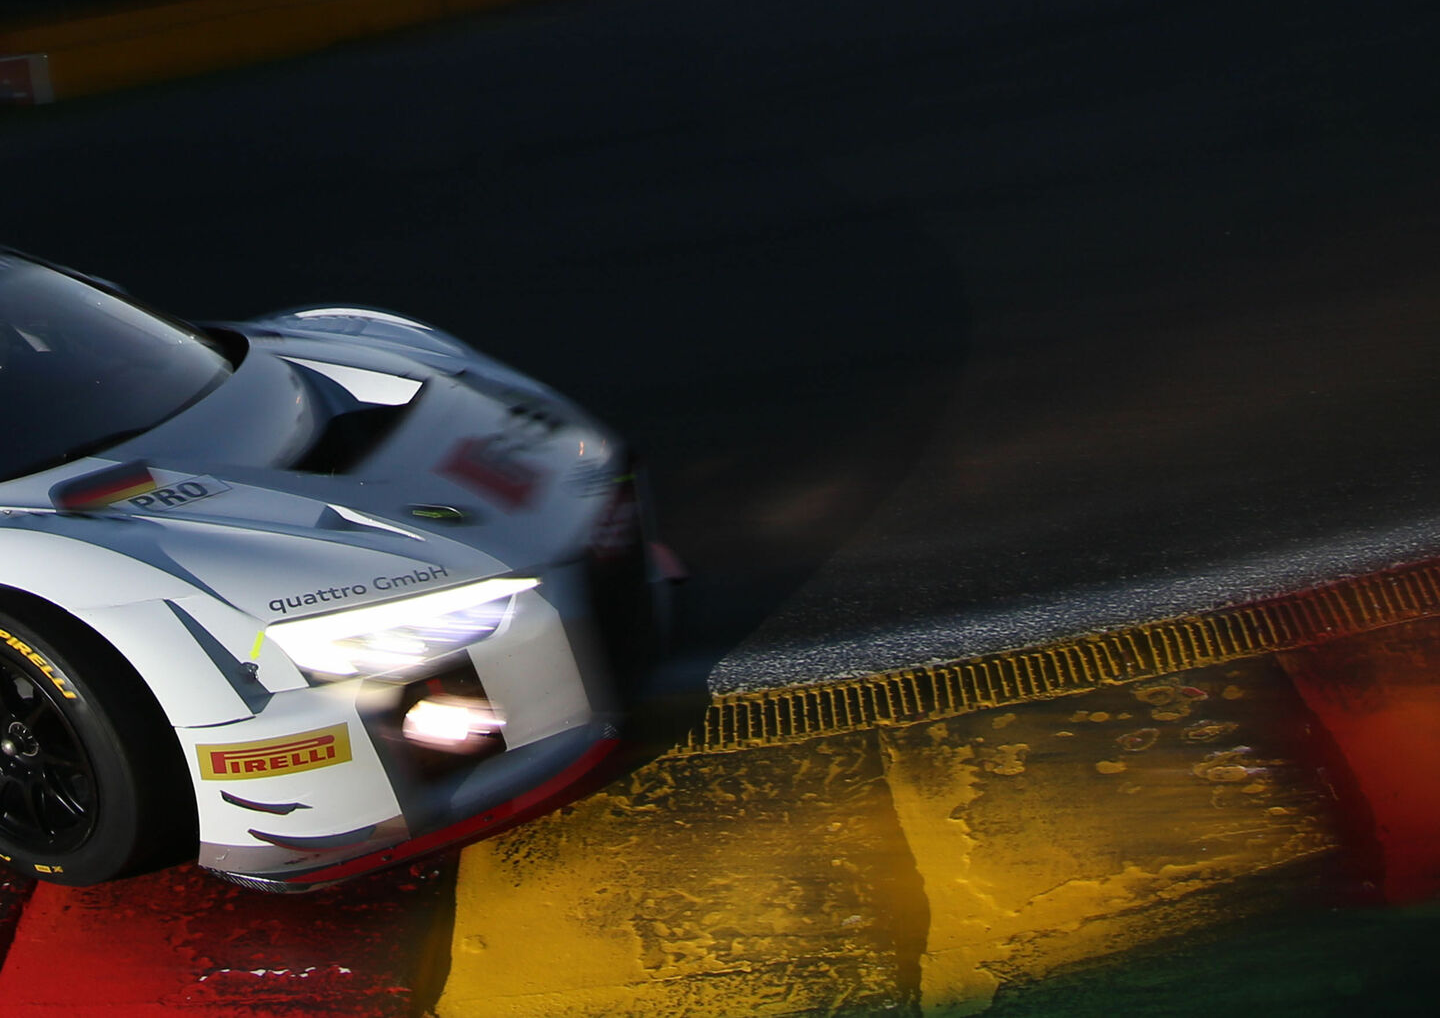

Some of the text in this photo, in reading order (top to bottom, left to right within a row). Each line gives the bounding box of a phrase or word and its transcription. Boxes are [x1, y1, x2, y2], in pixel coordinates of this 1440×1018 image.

[128, 482, 209, 512] PRO
[269, 565, 449, 614] quattro GmbH
[210, 735, 335, 774] PIRELLI
